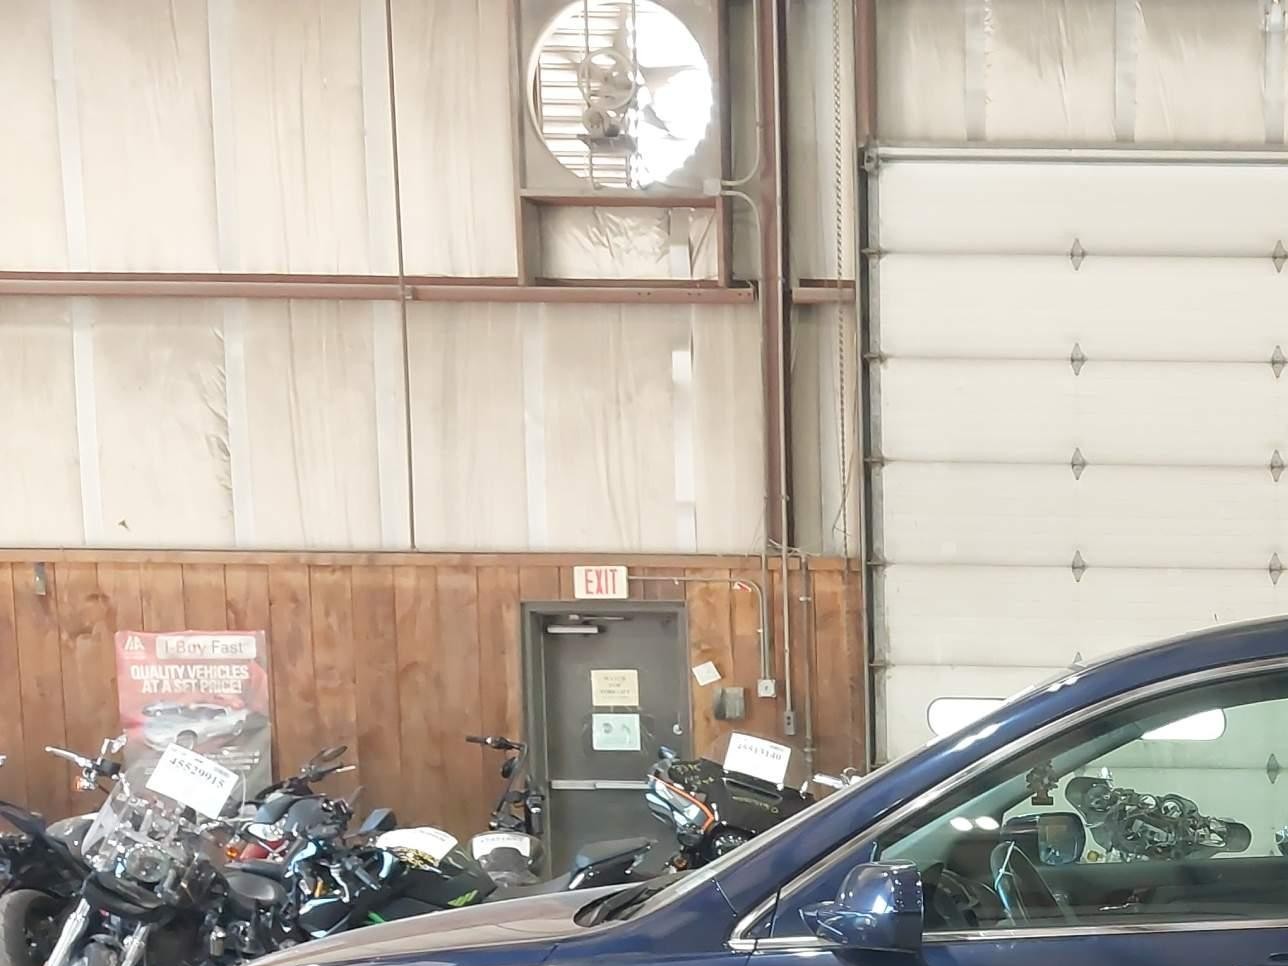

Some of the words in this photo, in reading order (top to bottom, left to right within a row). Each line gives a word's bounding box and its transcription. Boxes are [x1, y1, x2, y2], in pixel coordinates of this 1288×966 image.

[584, 568, 617, 595] EXIT
[211, 639, 245, 655] Fast
[130, 664, 186, 680] QUALITY
[187, 664, 250, 680] VEHICLES
[141, 680, 161, 694] AT
[161, 680, 173, 694] A
[174, 680, 199, 694] SET
[200, 680, 242, 694] PRICE!
